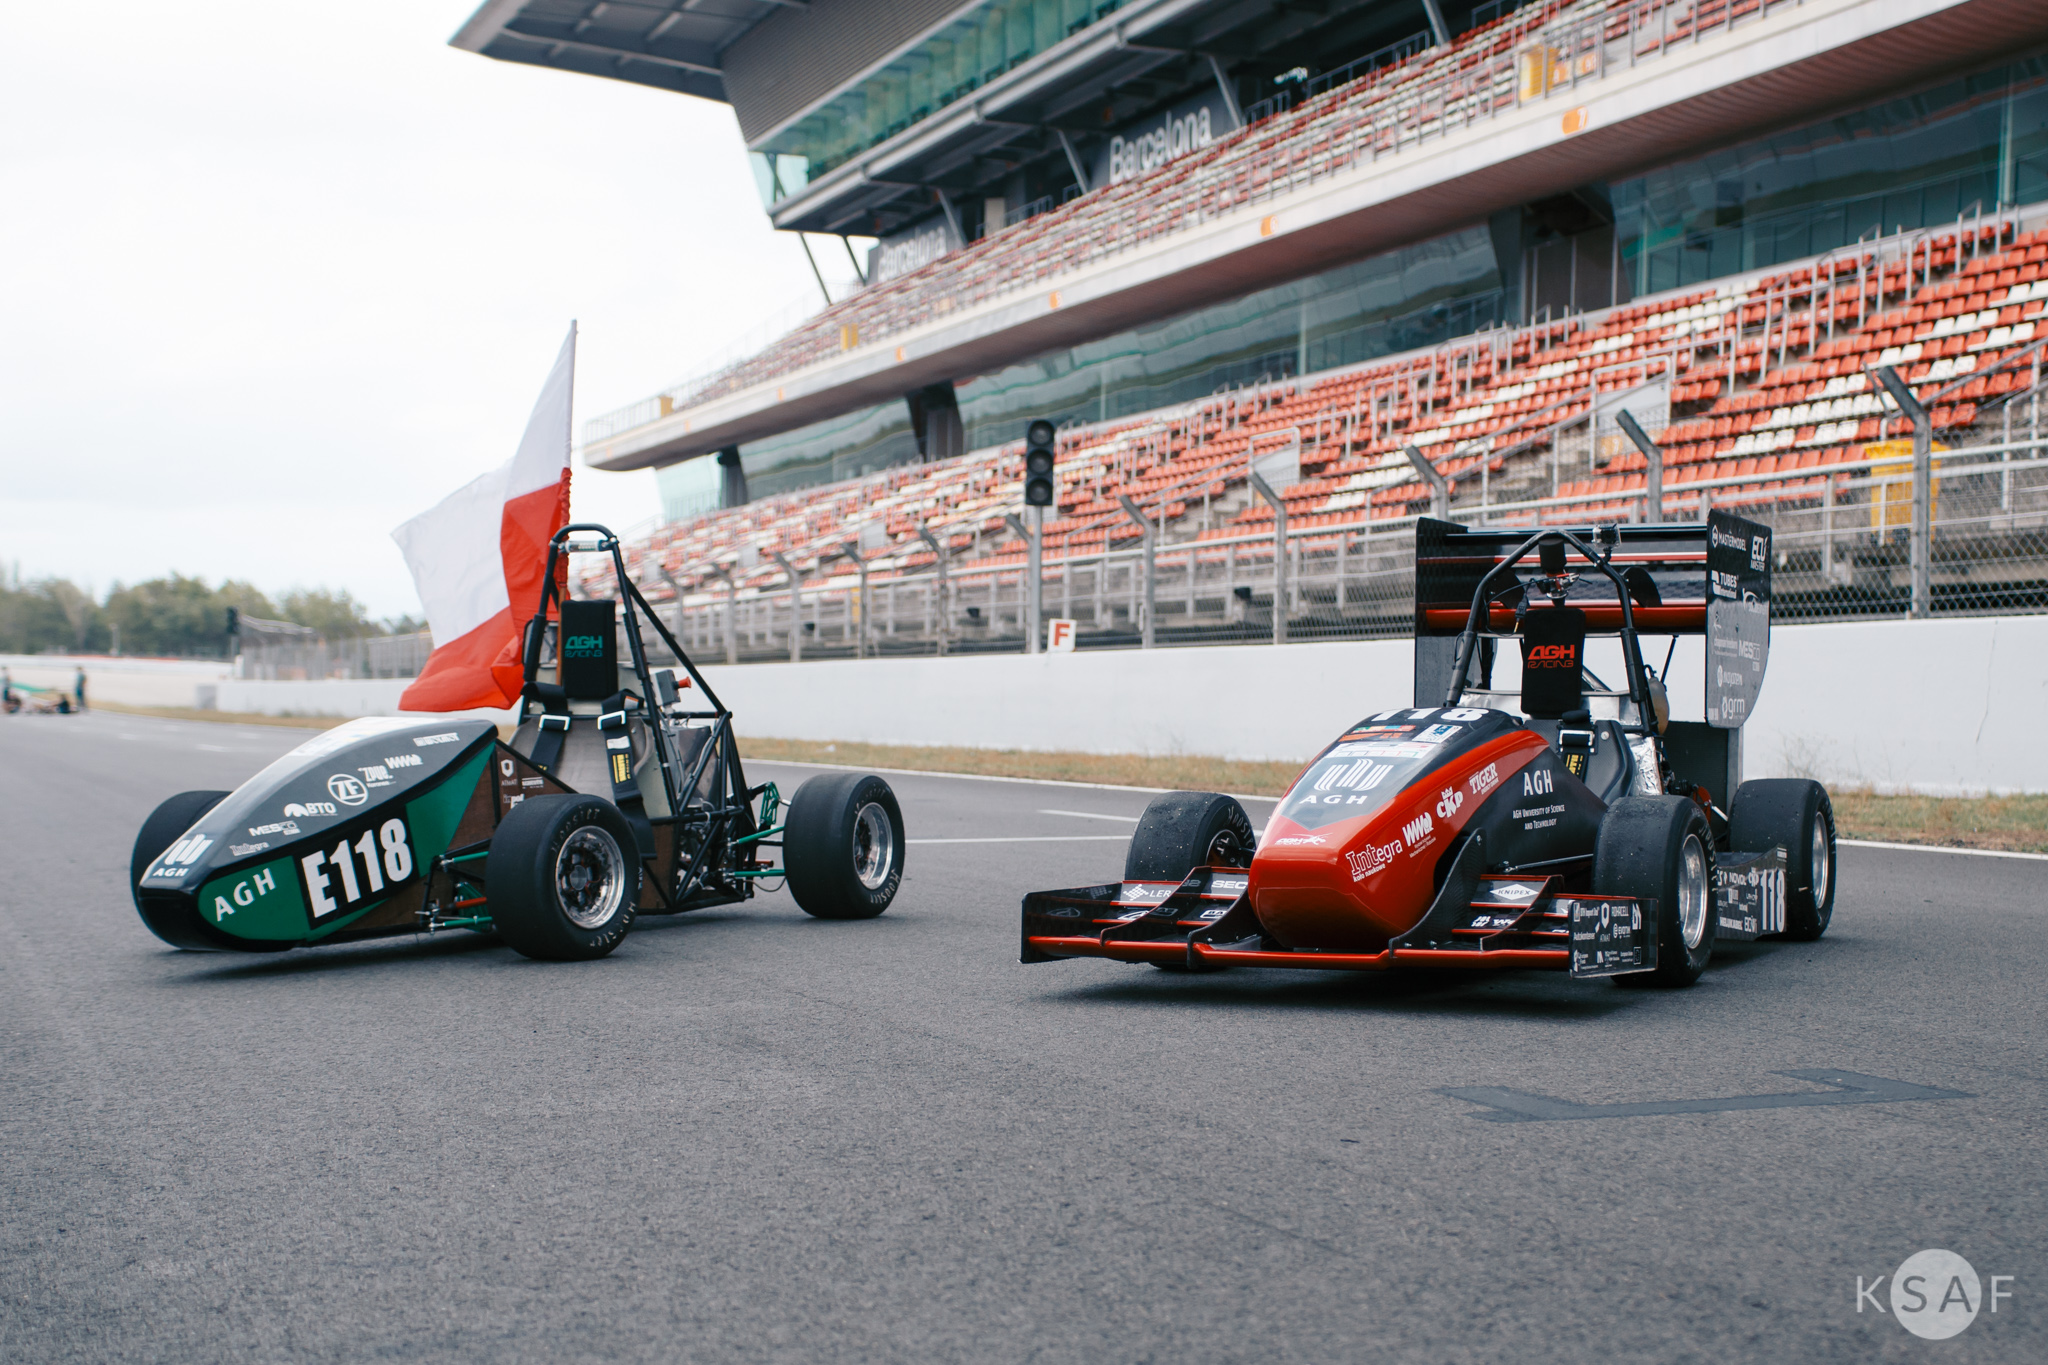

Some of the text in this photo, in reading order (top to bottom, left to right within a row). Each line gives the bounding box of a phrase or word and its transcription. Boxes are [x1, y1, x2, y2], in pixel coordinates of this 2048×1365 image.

[1109, 106, 1212, 184] Barcelona
[1720, 572, 1737, 588] TUBES
[565, 635, 603, 649] AGH
[1054, 623, 1070, 646] F
[1528, 644, 1575, 660] AGH
[1527, 660, 1574, 669] RACING
[337, 779, 359, 800] ZF
[1469, 762, 1498, 794] TIGER
[1523, 769, 1553, 796] AGH
[1299, 795, 1368, 804] AGH
[301, 818, 413, 919] E118
[1345, 844, 1403, 875] Integra
[153, 868, 190, 877] AGH
[214, 868, 276, 922] AGH
[1761, 868, 1785, 932] 118
